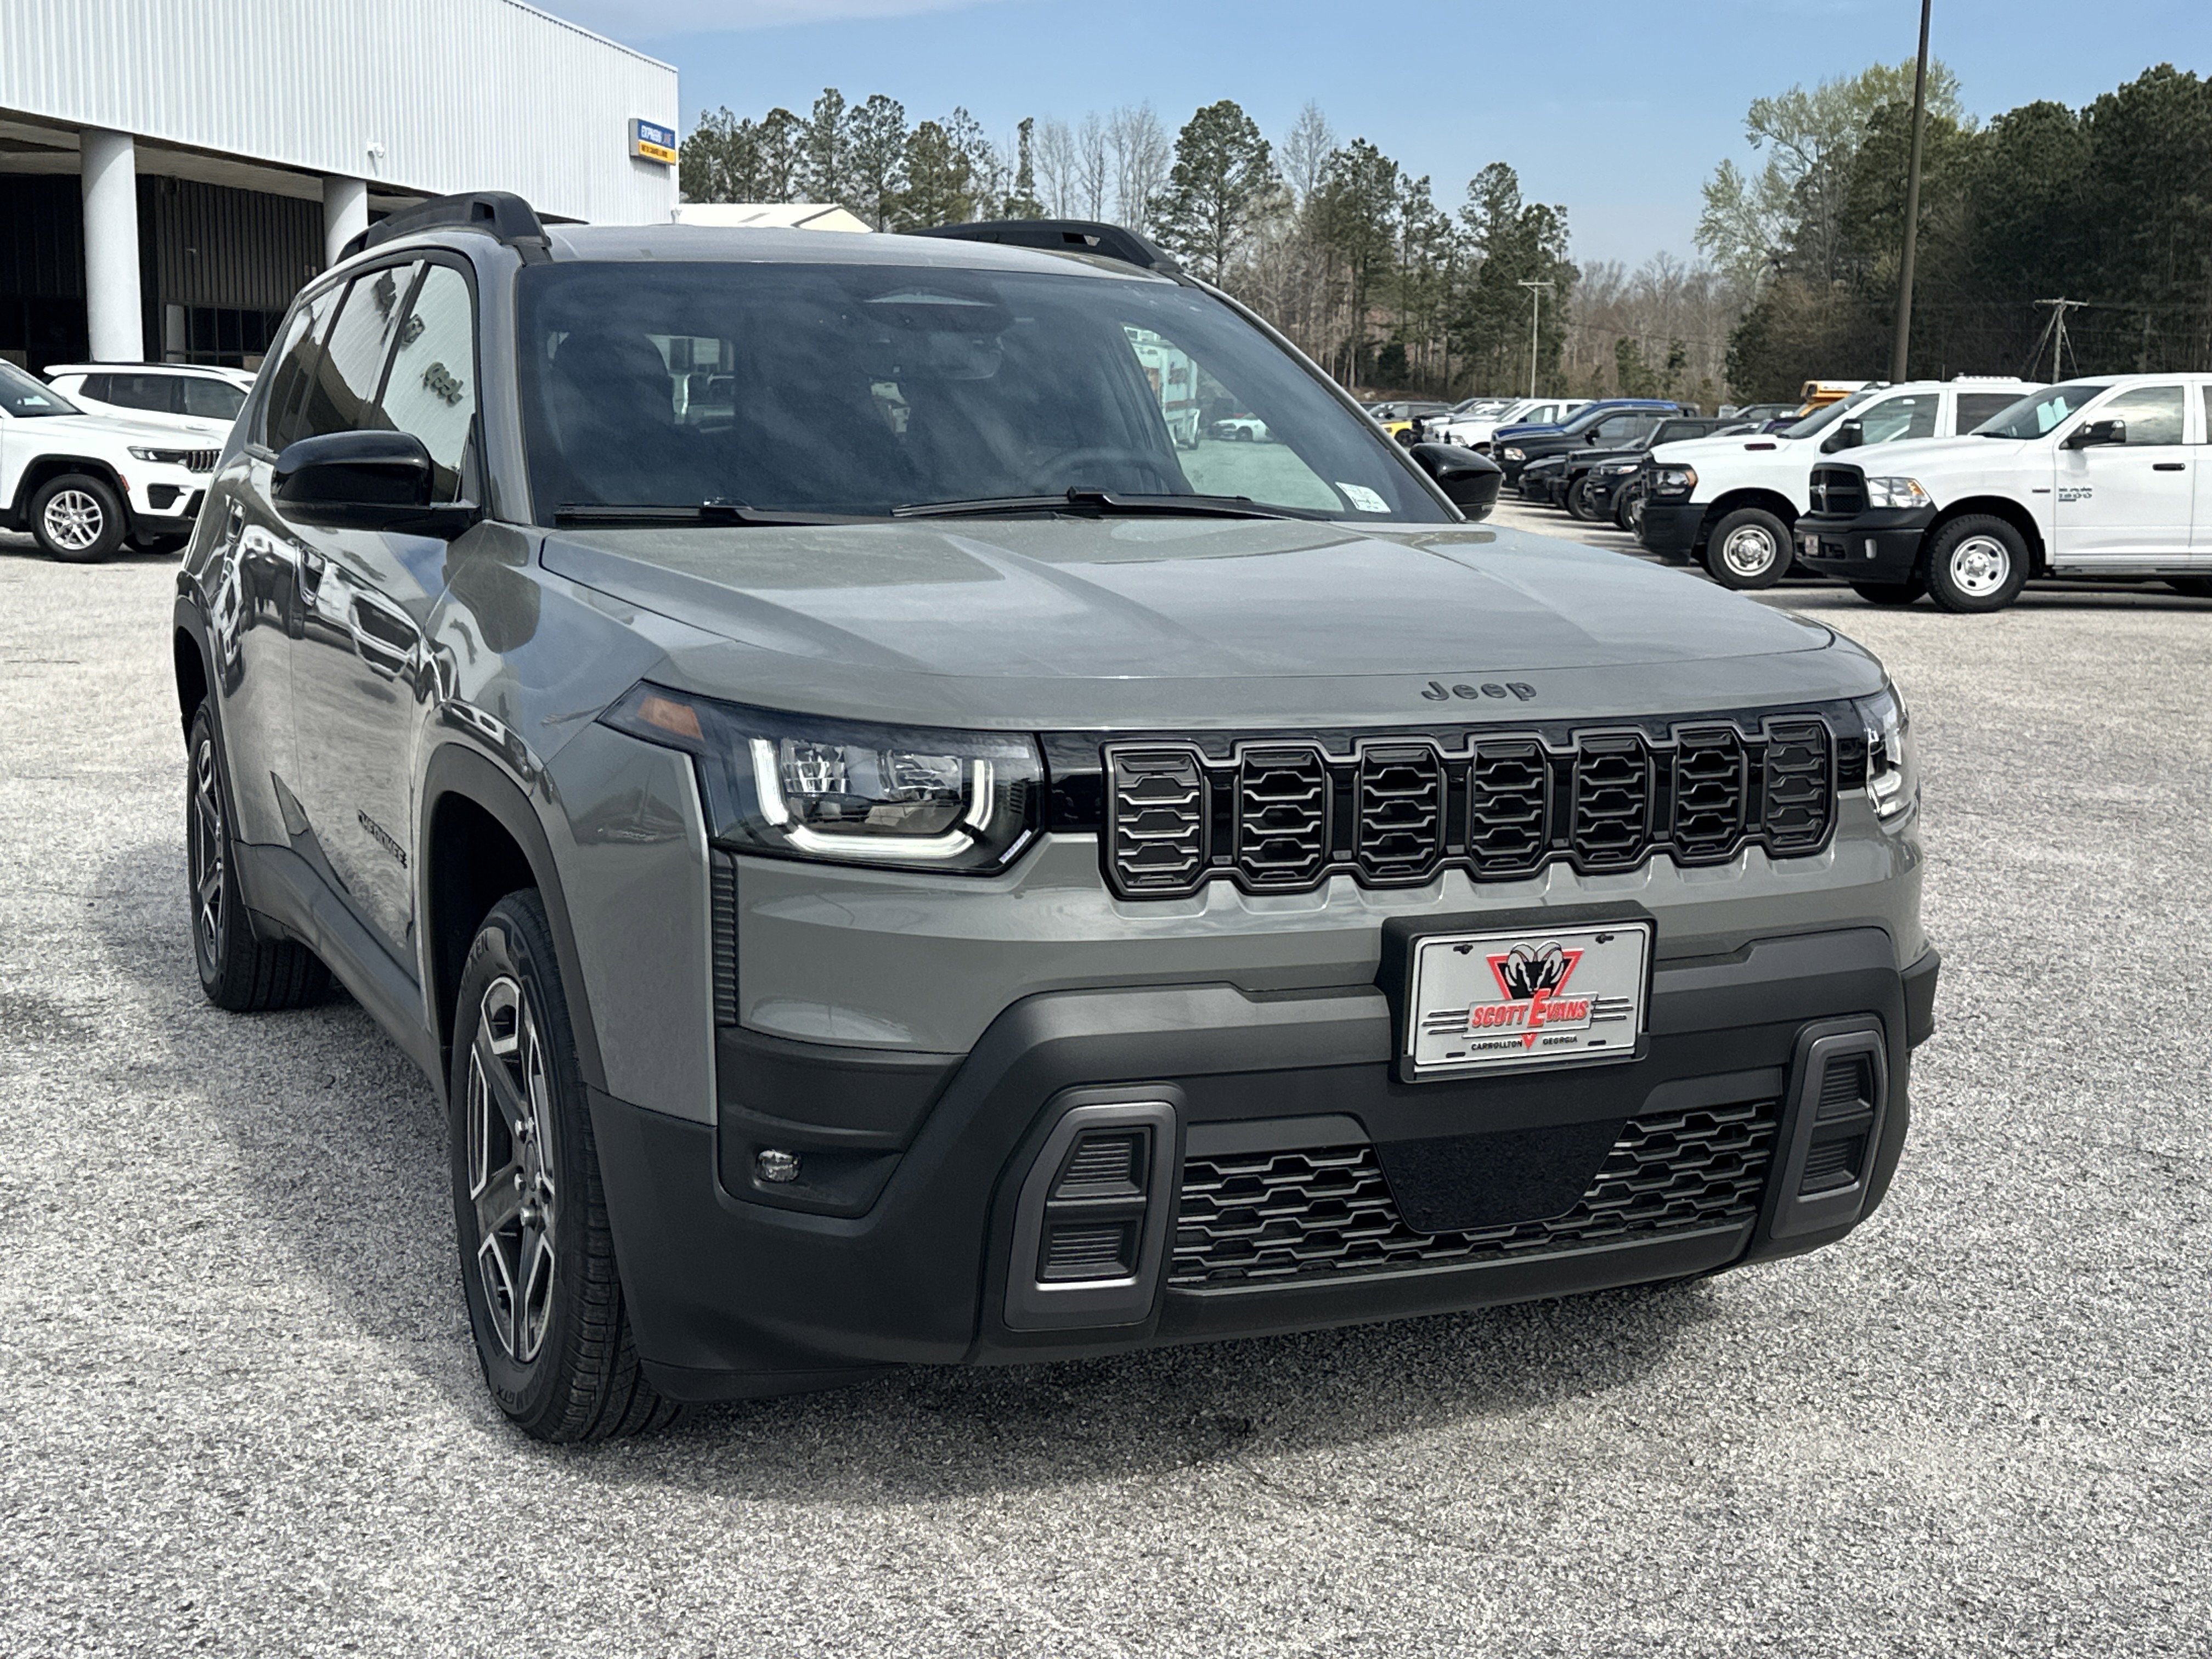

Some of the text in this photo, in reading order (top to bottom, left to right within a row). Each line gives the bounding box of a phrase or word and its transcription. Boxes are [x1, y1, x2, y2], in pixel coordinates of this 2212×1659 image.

[1421, 681, 1537, 701] Jeep
[1471, 988, 1589, 1028] SCOTT EVANS
[1471, 1035, 1578, 1051] CARROLLTON GEORGIA
[496, 1384, 516, 1405] GTX
